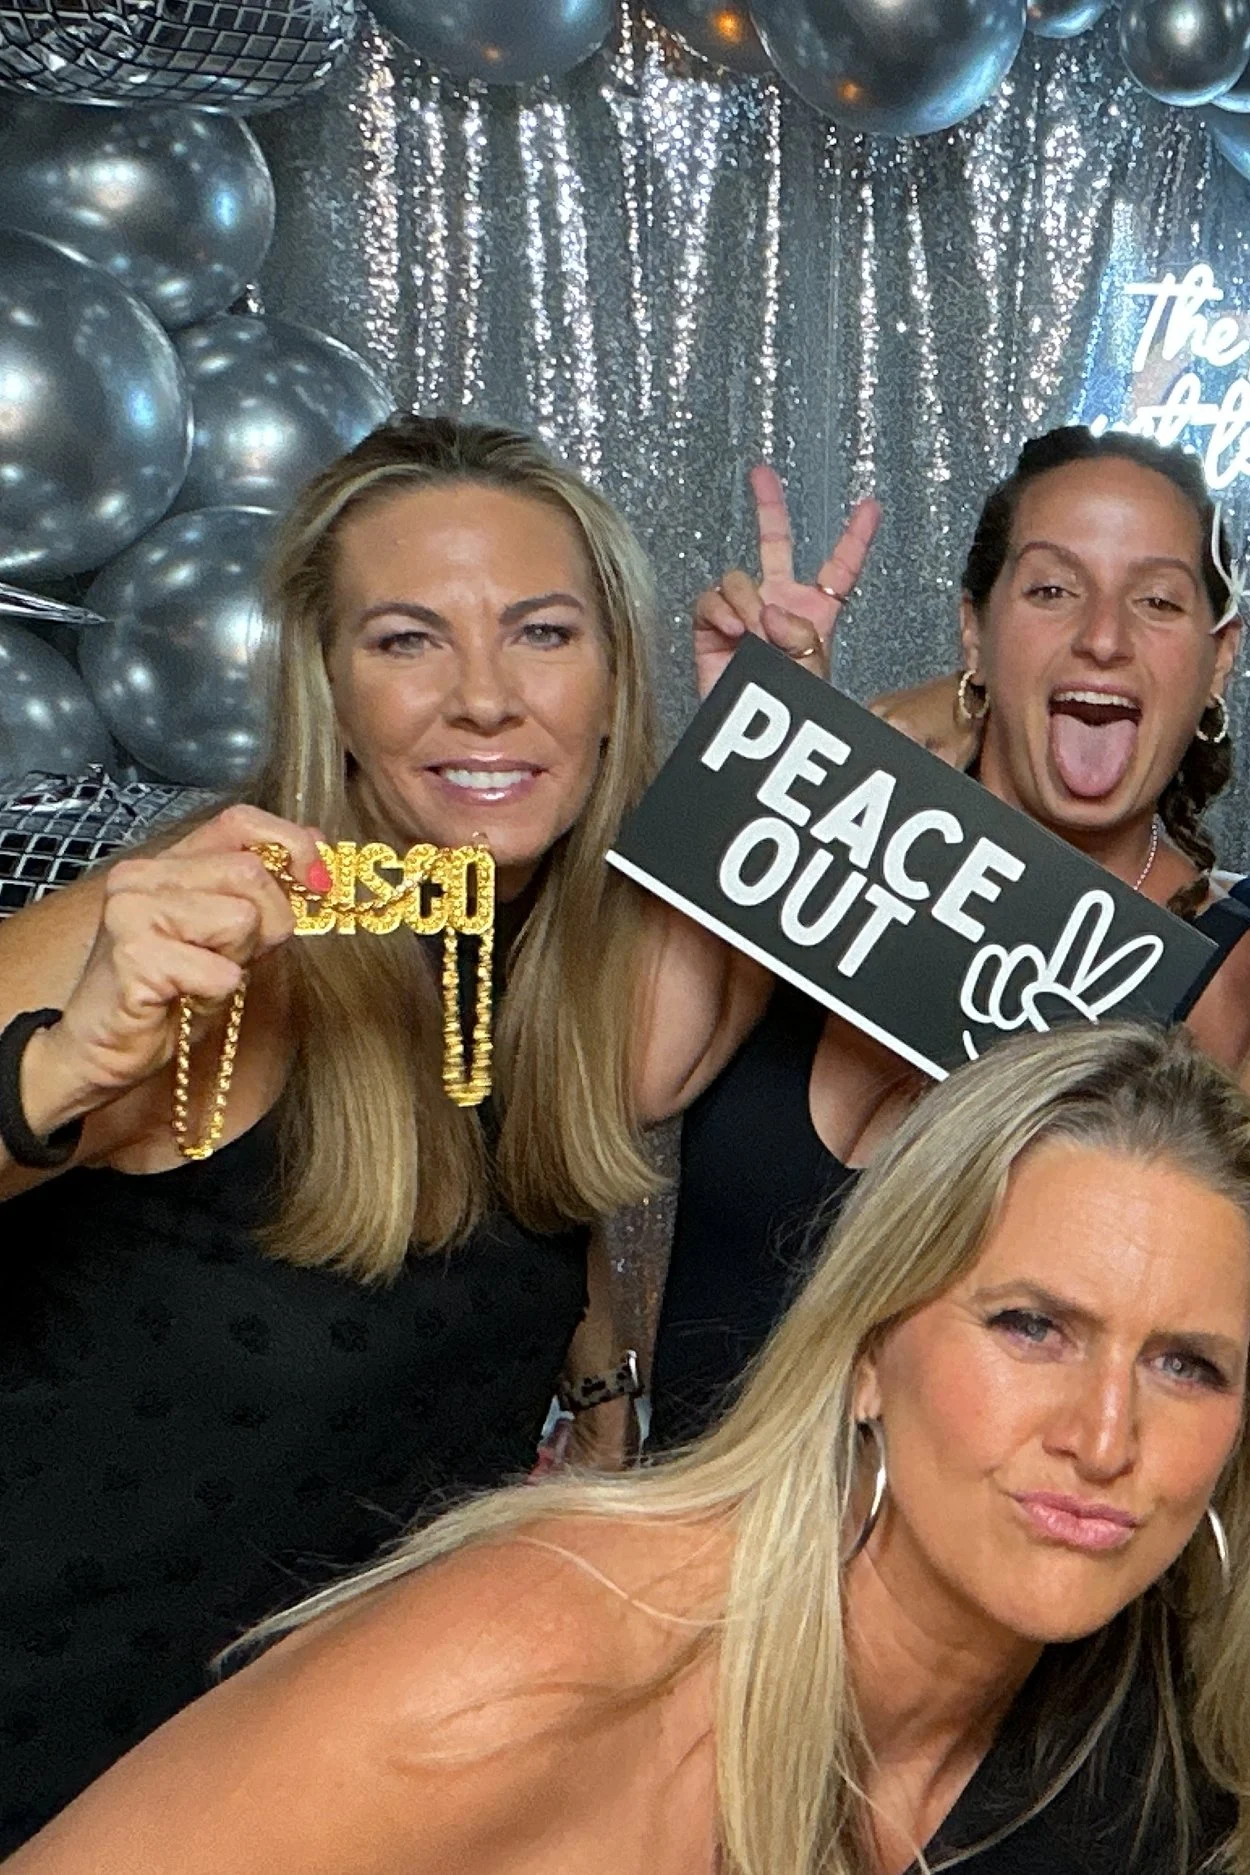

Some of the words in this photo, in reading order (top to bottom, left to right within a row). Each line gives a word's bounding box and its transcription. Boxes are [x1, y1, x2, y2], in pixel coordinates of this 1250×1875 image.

[1124, 263, 1250, 372] The
[701, 682, 1026, 943] PEACE
[718, 816, 916, 978] OUT
